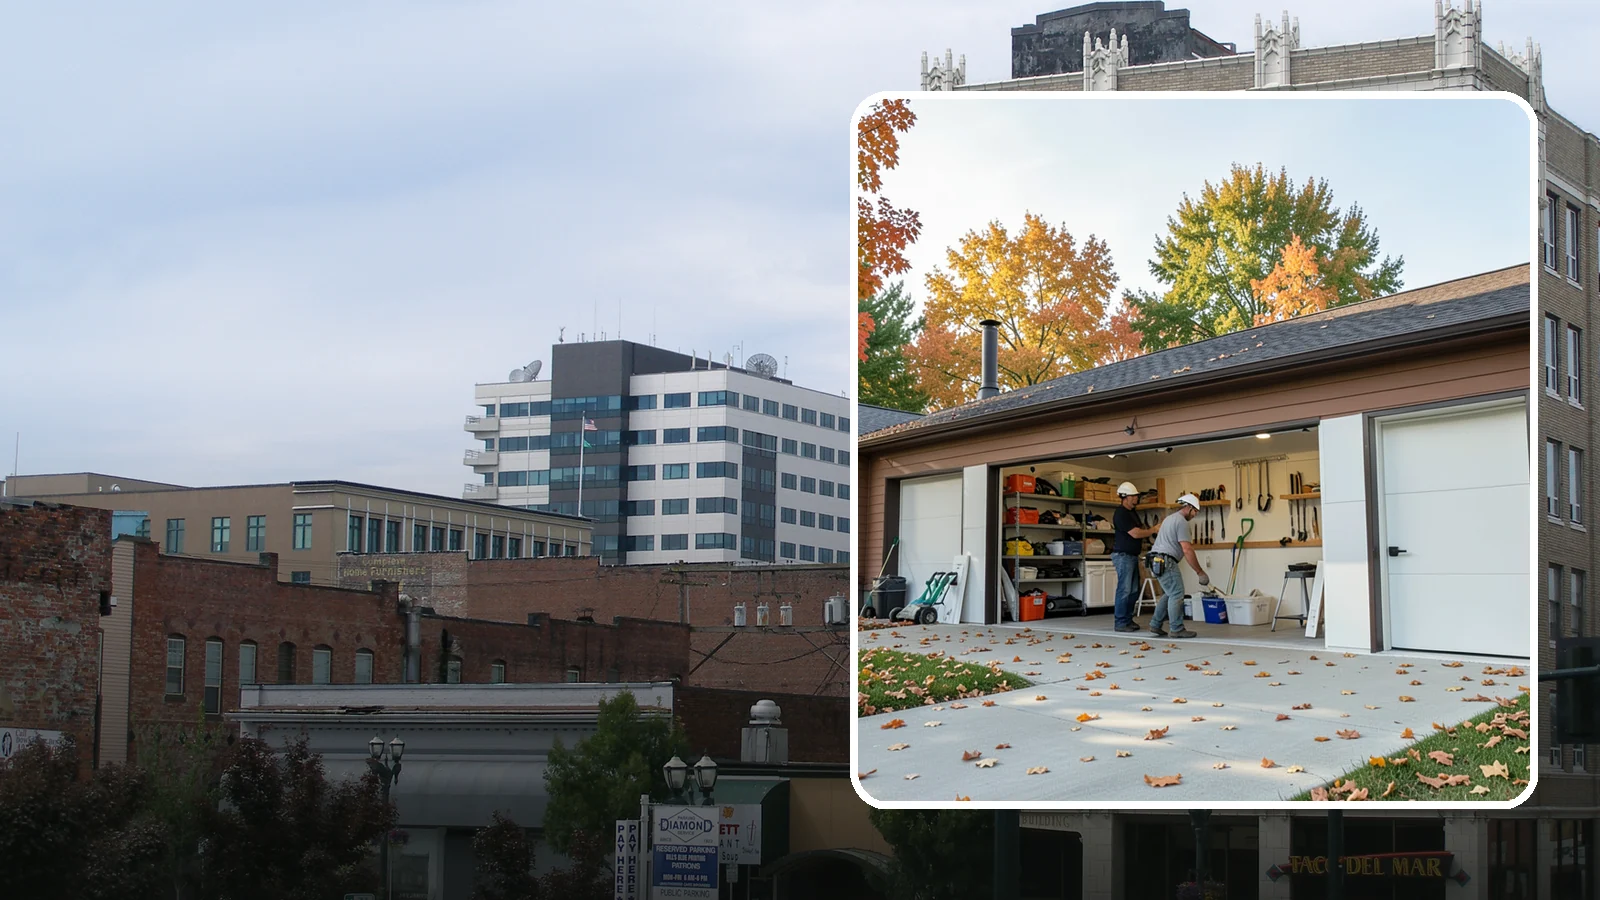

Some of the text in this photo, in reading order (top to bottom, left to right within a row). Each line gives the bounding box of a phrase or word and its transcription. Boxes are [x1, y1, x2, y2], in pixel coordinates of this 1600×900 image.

[371, 566, 427, 576] Furnishers
[660, 818, 712, 832] DIAMOND
[1022, 815, 1070, 828] BUILDING
[722, 852, 738, 861] Soup
[1346, 857, 1385, 876] DEL
[1392, 857, 1442, 877] MAR
[617, 856, 625, 893] HERE
[628, 856, 636, 893] HERE
[684, 890, 710, 898] PARKING
